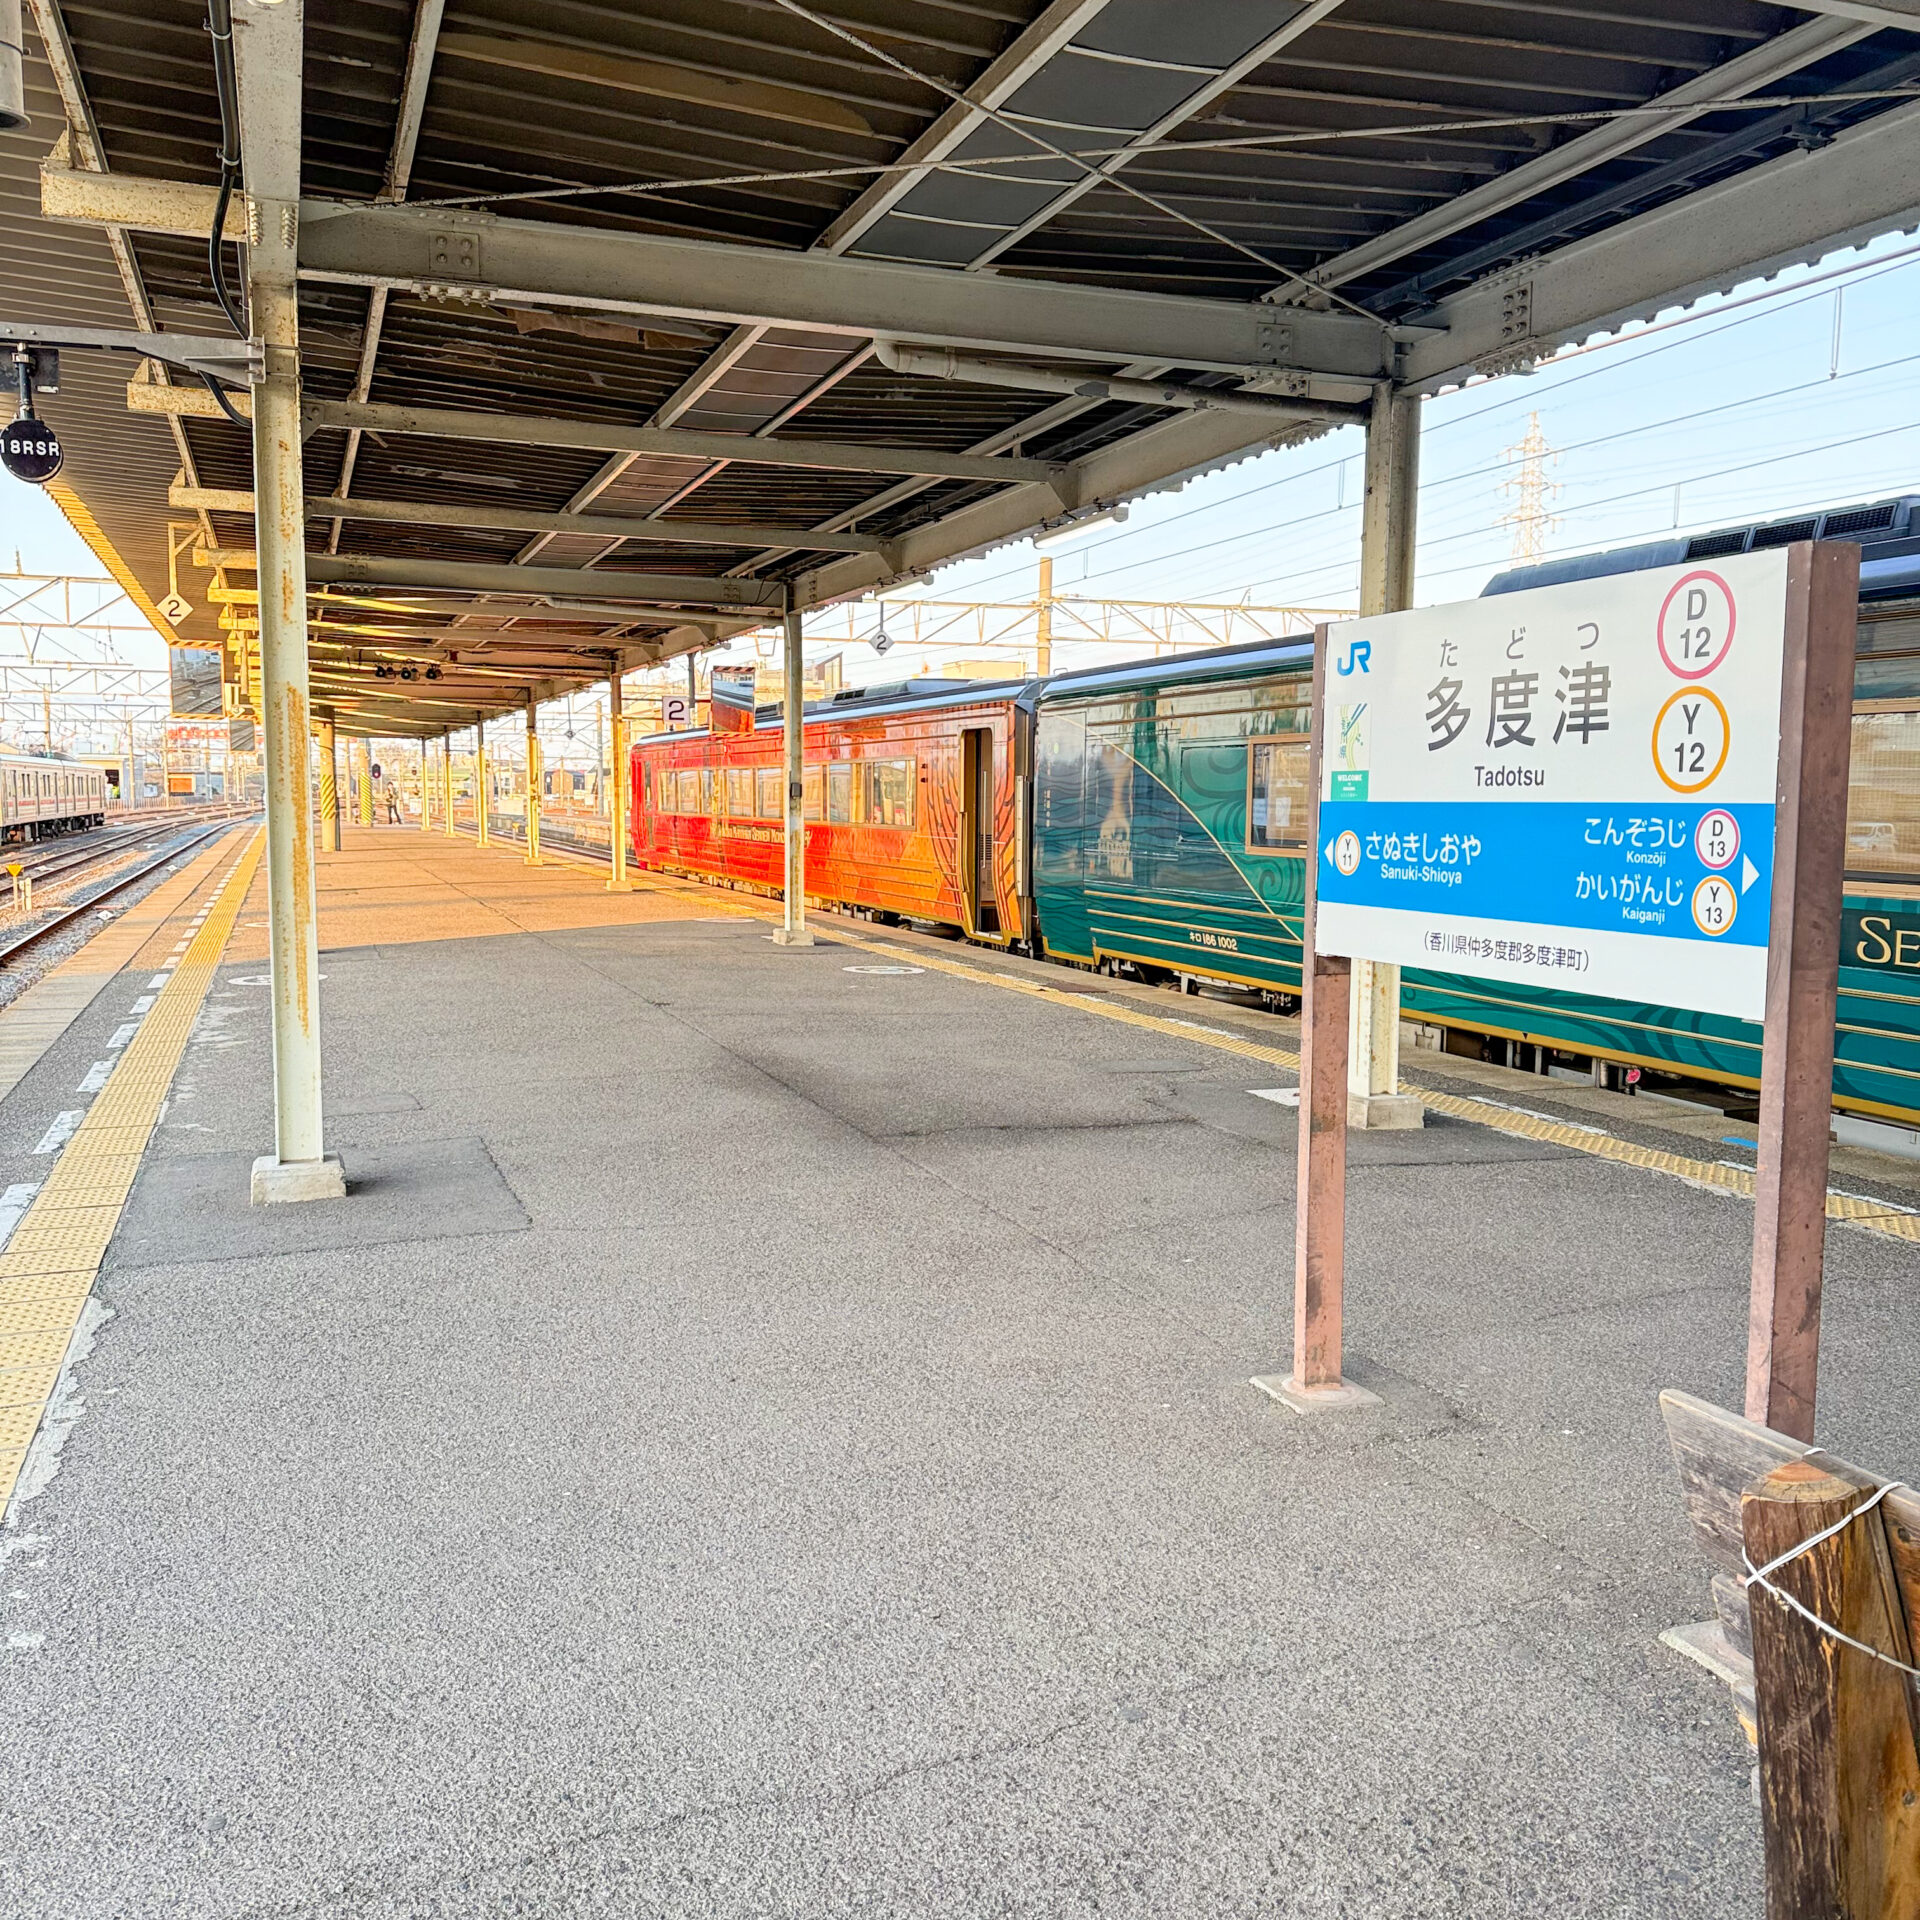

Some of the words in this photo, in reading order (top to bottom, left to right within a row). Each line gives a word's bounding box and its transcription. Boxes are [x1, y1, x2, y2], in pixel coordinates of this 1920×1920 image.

[0, 439, 60, 456] 18RSR
[168, 599, 182, 617] 2
[1686, 588, 1708, 621] D
[876, 634, 887, 650] 2
[1680, 626, 1712, 659] 12
[1337, 640, 1371, 677] JR
[668, 700, 685, 721] 2
[1425, 660, 1612, 752] 多度津
[1682, 703, 1702, 735] Y
[1674, 741, 1705, 773] 12
[1474, 765, 1545, 787] Tadotsu
[1584, 817, 1687, 849] こんぞうじ
[1711, 819, 1724, 837] D
[1344, 838, 1352, 851] Y
[1365, 831, 1482, 866] さぬきしおや
[1708, 841, 1726, 858] 13
[1342, 854, 1352, 867] 11
[1626, 850, 1667, 867] Konzōji
[1380, 863, 1463, 887] Sanuki-Shioya
[1575, 871, 1684, 906] かいがんじ
[1709, 886, 1721, 903] Y
[1622, 906, 1666, 925] Kaiganji
[1705, 907, 1723, 924] 13
